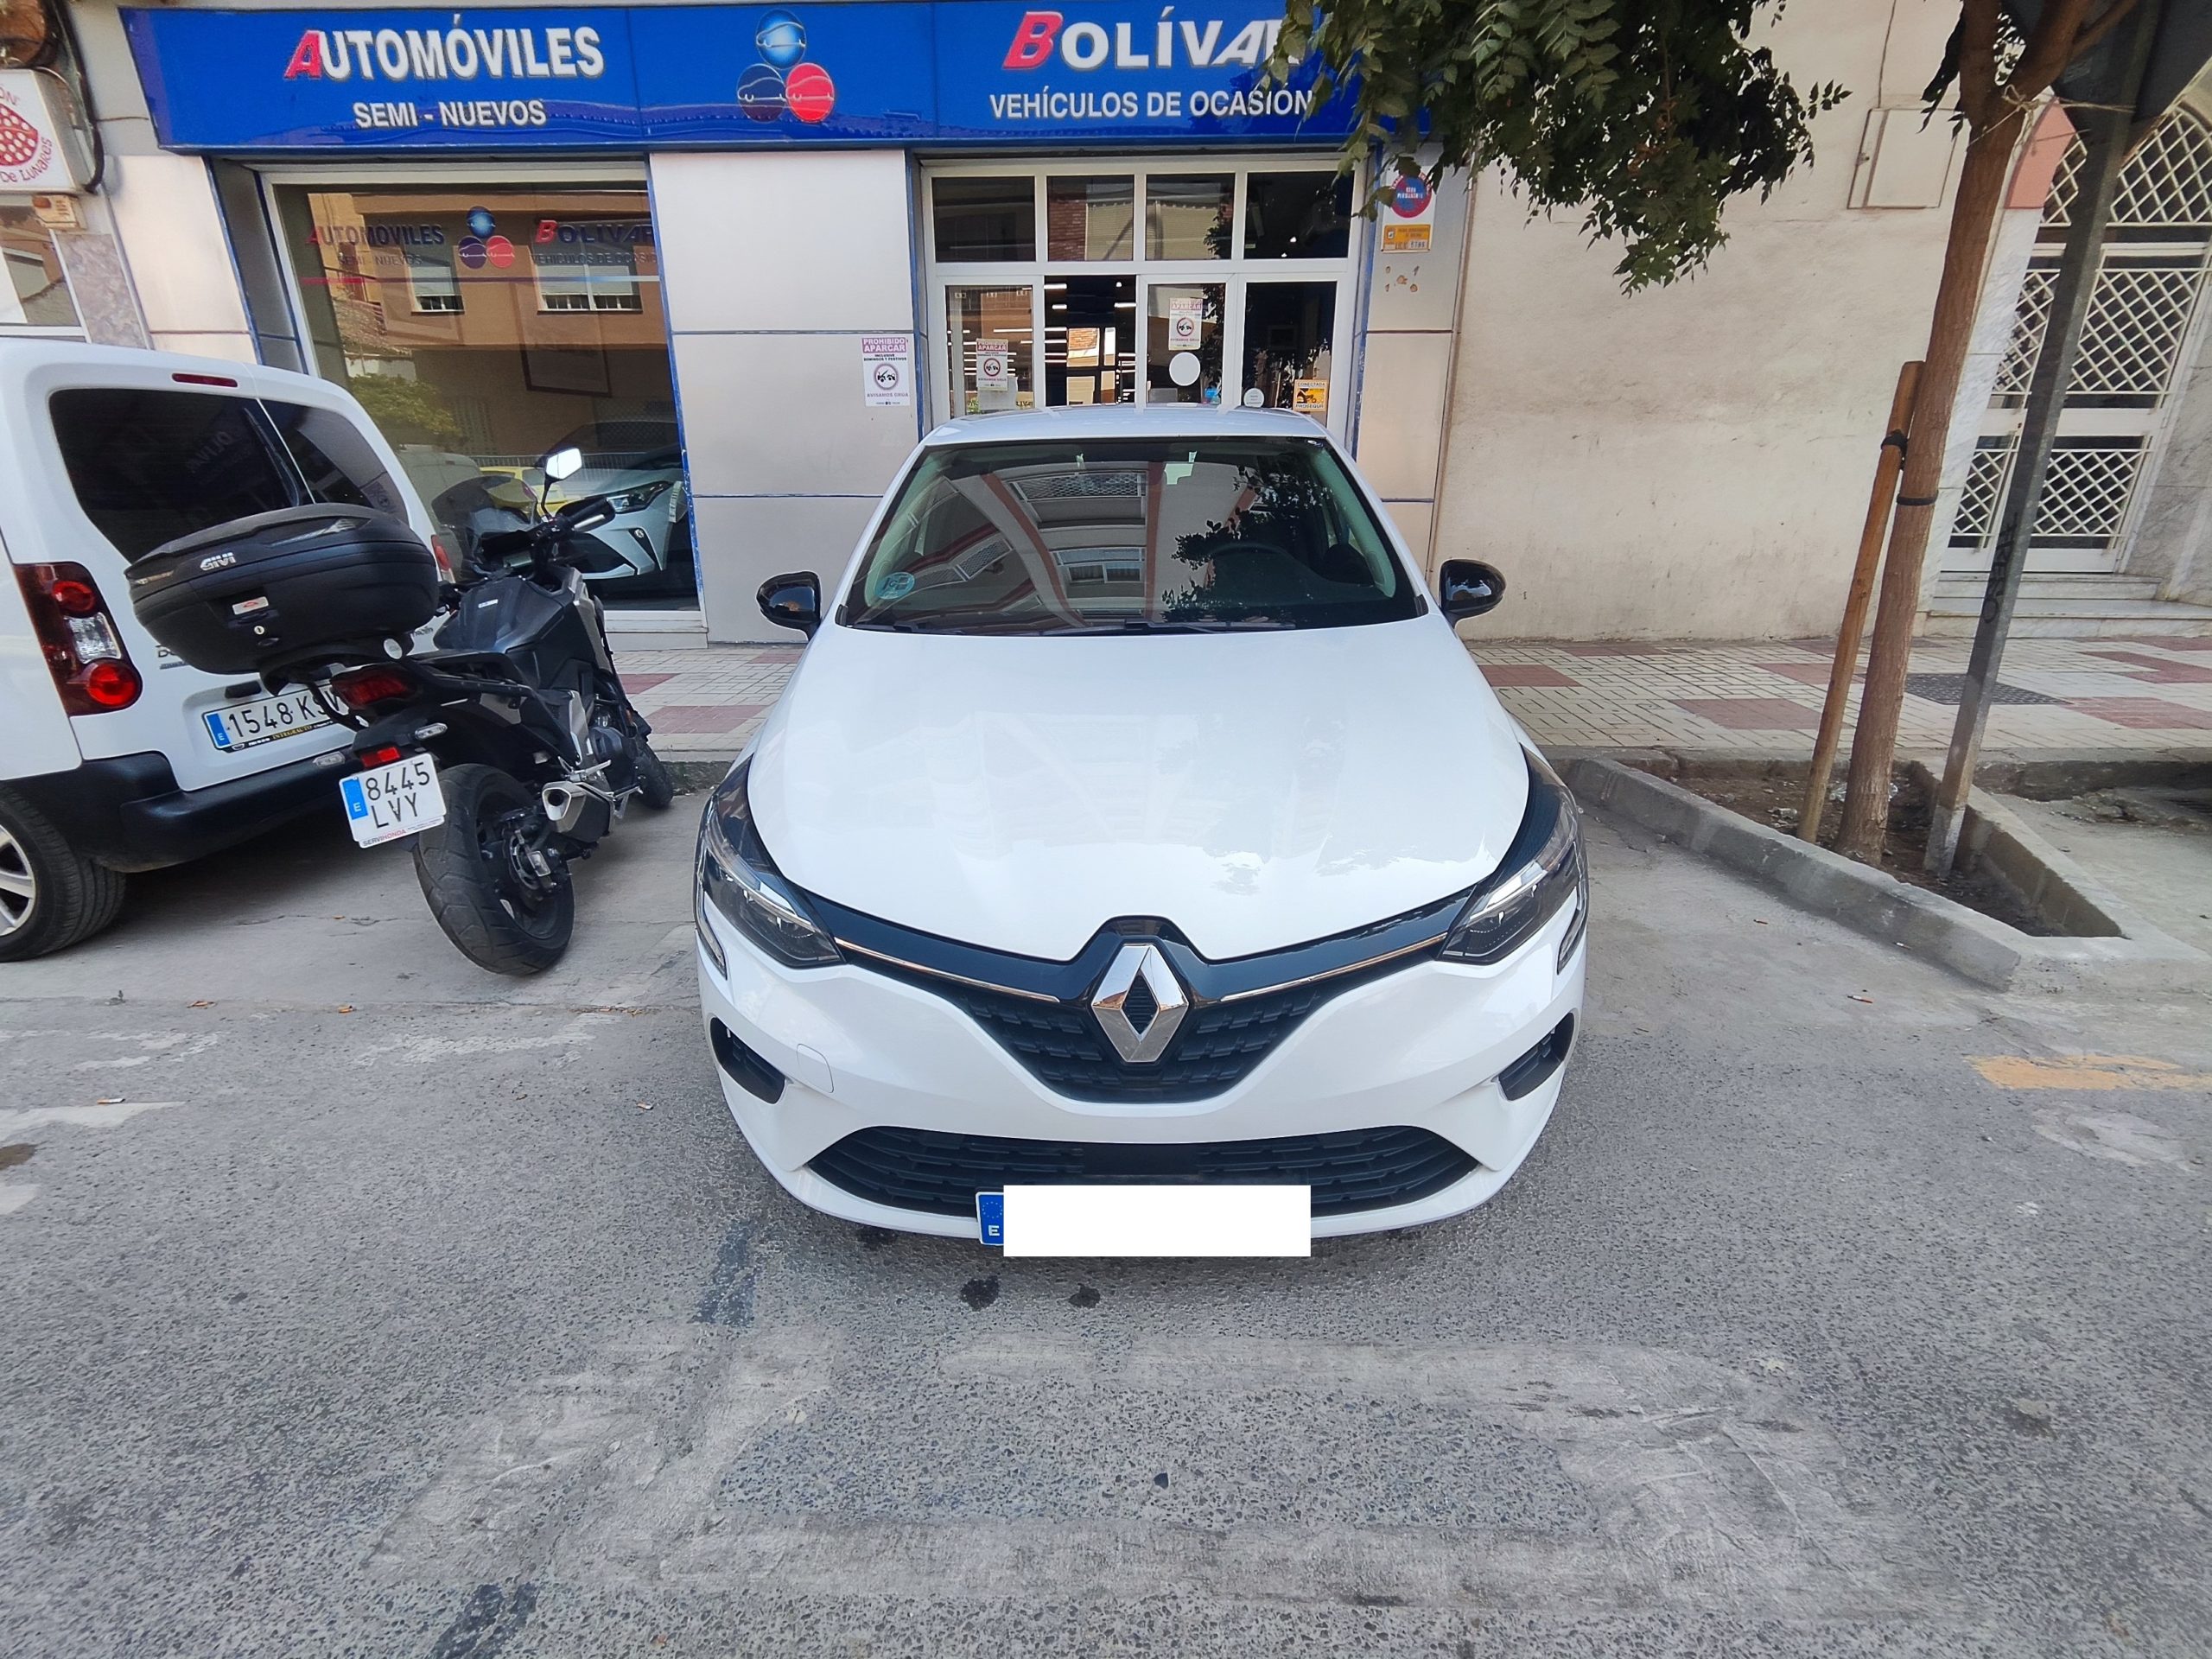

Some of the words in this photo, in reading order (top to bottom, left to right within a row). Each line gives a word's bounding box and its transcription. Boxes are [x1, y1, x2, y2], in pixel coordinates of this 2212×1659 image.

[283, 14, 604, 79] AUTOMÓVILES
[353, 101, 418, 128] SEMI
[439, 99, 547, 127] NUEVOS
[989, 86, 1139, 119] VEHÍCULOS
[1147, 91, 1182, 118] DE
[200, 551, 237, 571] GIVI
[228, 702, 294, 738] 1548
[365, 761, 431, 801] 8445
[353, 801, 362, 812] E
[371, 791, 418, 830] LVY
[988, 1224, 1001, 1237] E
